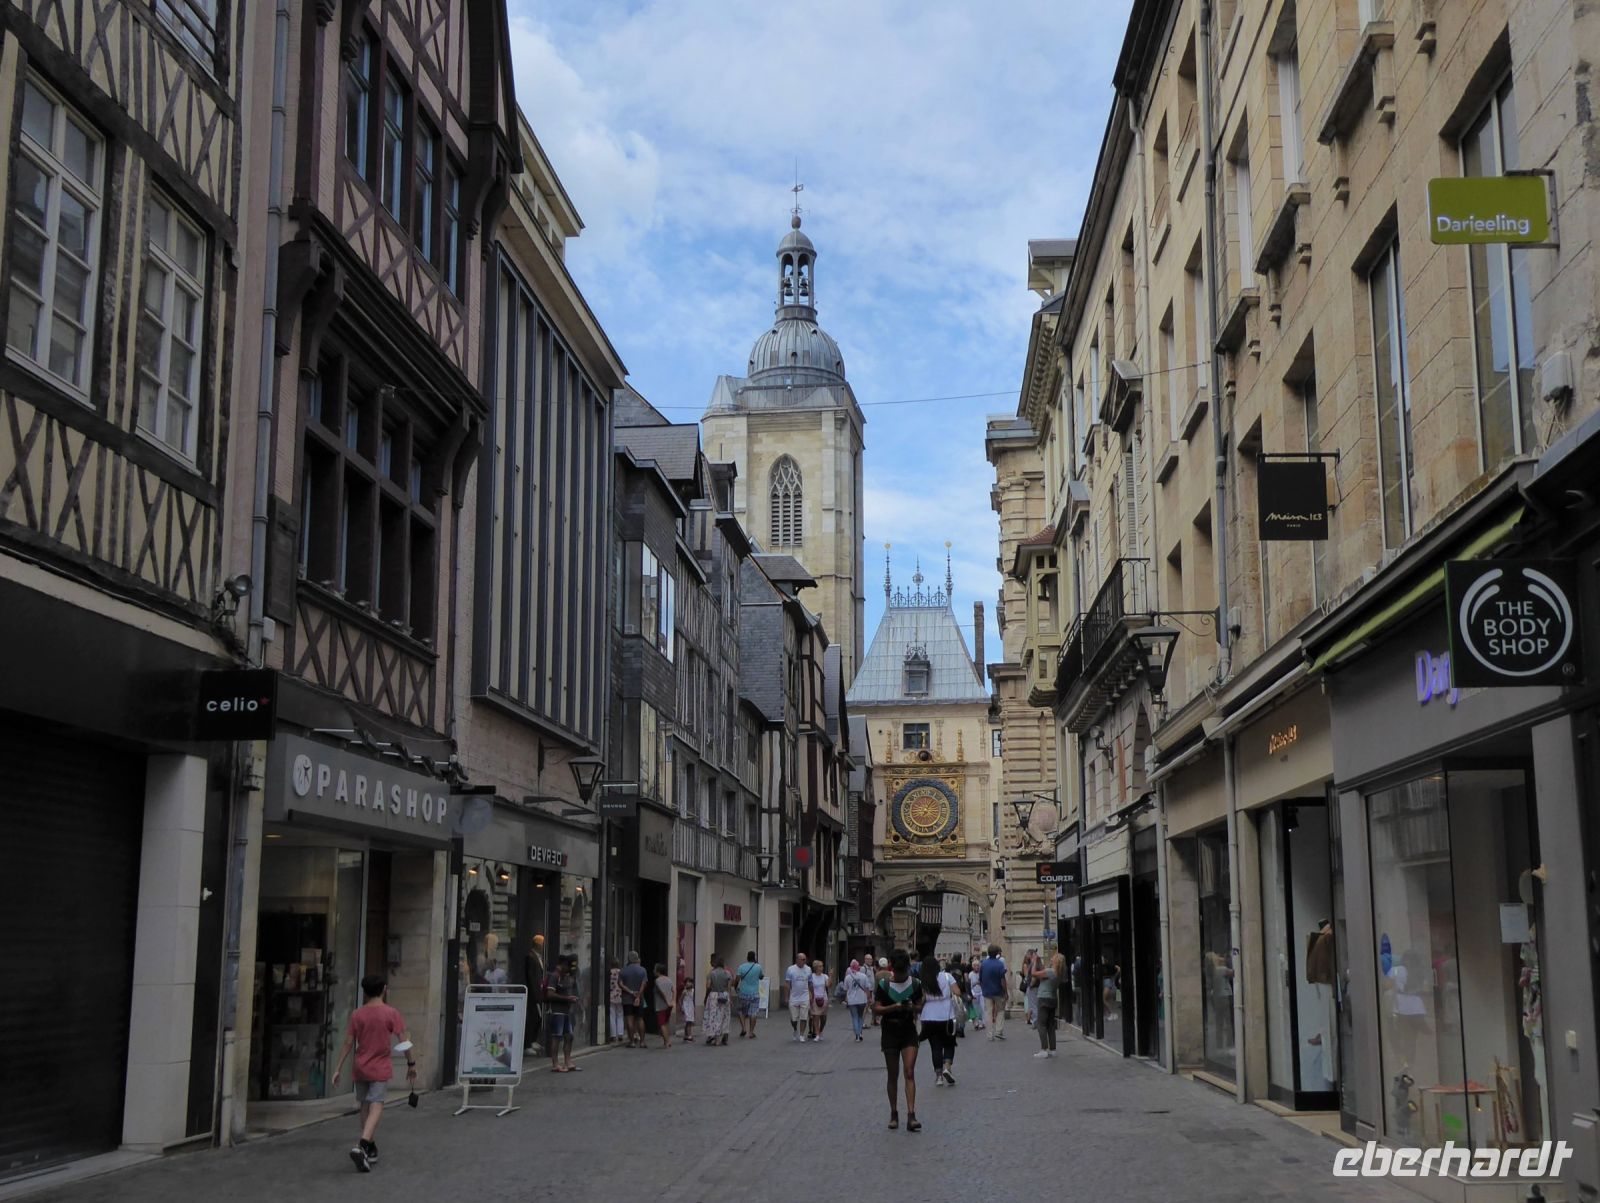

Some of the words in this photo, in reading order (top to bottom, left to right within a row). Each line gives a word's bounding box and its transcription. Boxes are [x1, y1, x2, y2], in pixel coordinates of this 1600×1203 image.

[1436, 214, 1530, 235] Darjeeling
[1495, 600, 1535, 616] THE
[1483, 617, 1551, 637] BODY
[1488, 637, 1550, 656] SHOP
[206, 697, 259, 712] celio
[316, 763, 448, 825] PARASHOP
